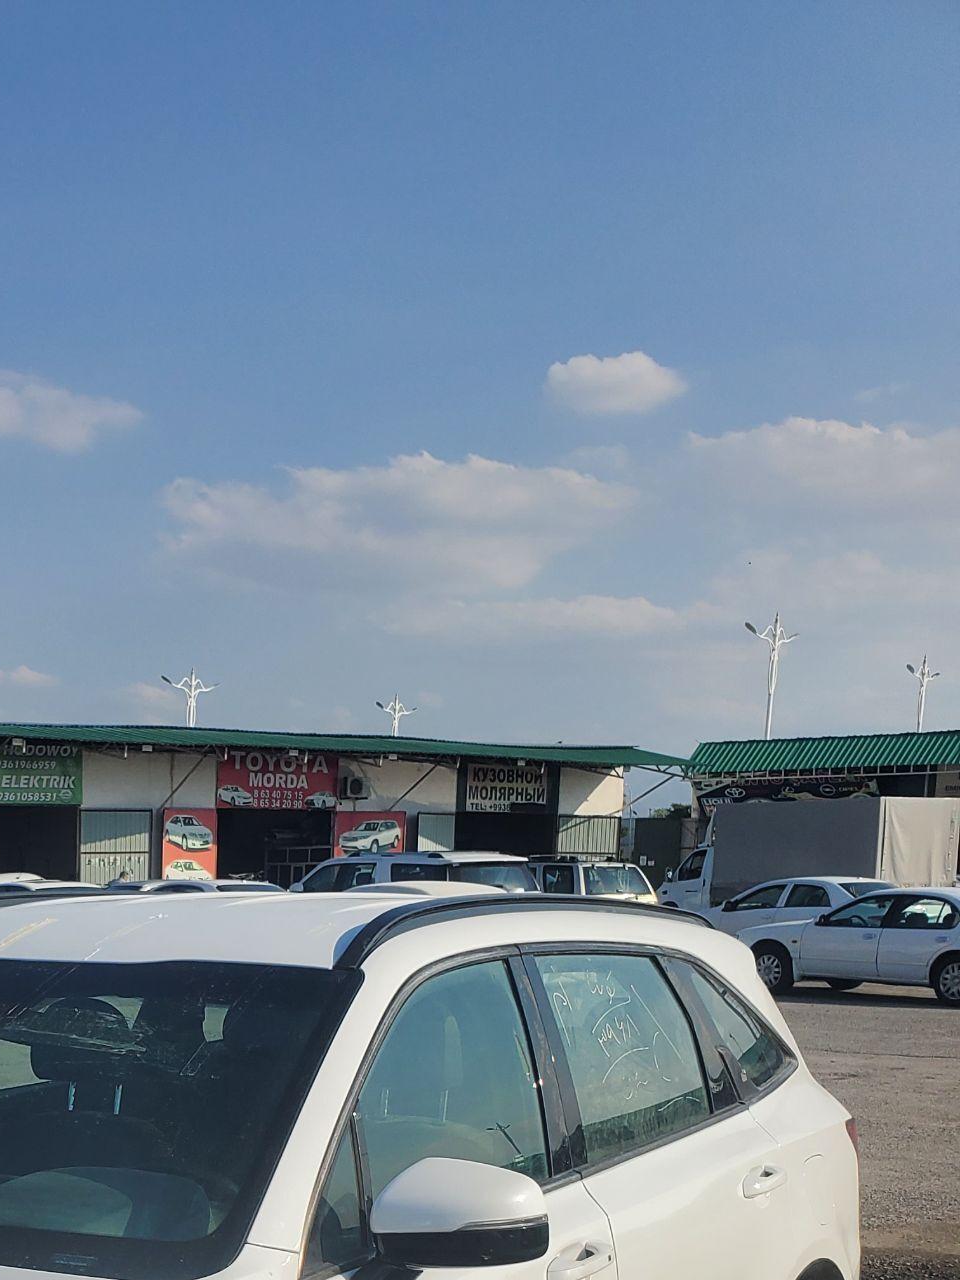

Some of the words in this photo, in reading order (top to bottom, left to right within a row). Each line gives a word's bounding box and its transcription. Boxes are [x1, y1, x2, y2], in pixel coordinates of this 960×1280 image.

[230, 751, 329, 774] TOYOTA
[1, 775, 76, 789] ELEKTRIK
[249, 773, 308, 790] MORDA
[473, 766, 543, 785] КУЗОВНОЙ
[254, 790, 258, 798] 8
[260, 791, 270, 799] 63
[271, 791, 281, 799] 40
[283, 791, 292, 799] 75
[468, 784, 545, 803] МОЛЯРНЫЙ
[253, 799, 258, 807] 8
[259, 799, 269, 807] 65
[282, 800, 292, 808] 20
[293, 800, 302, 808] 90
